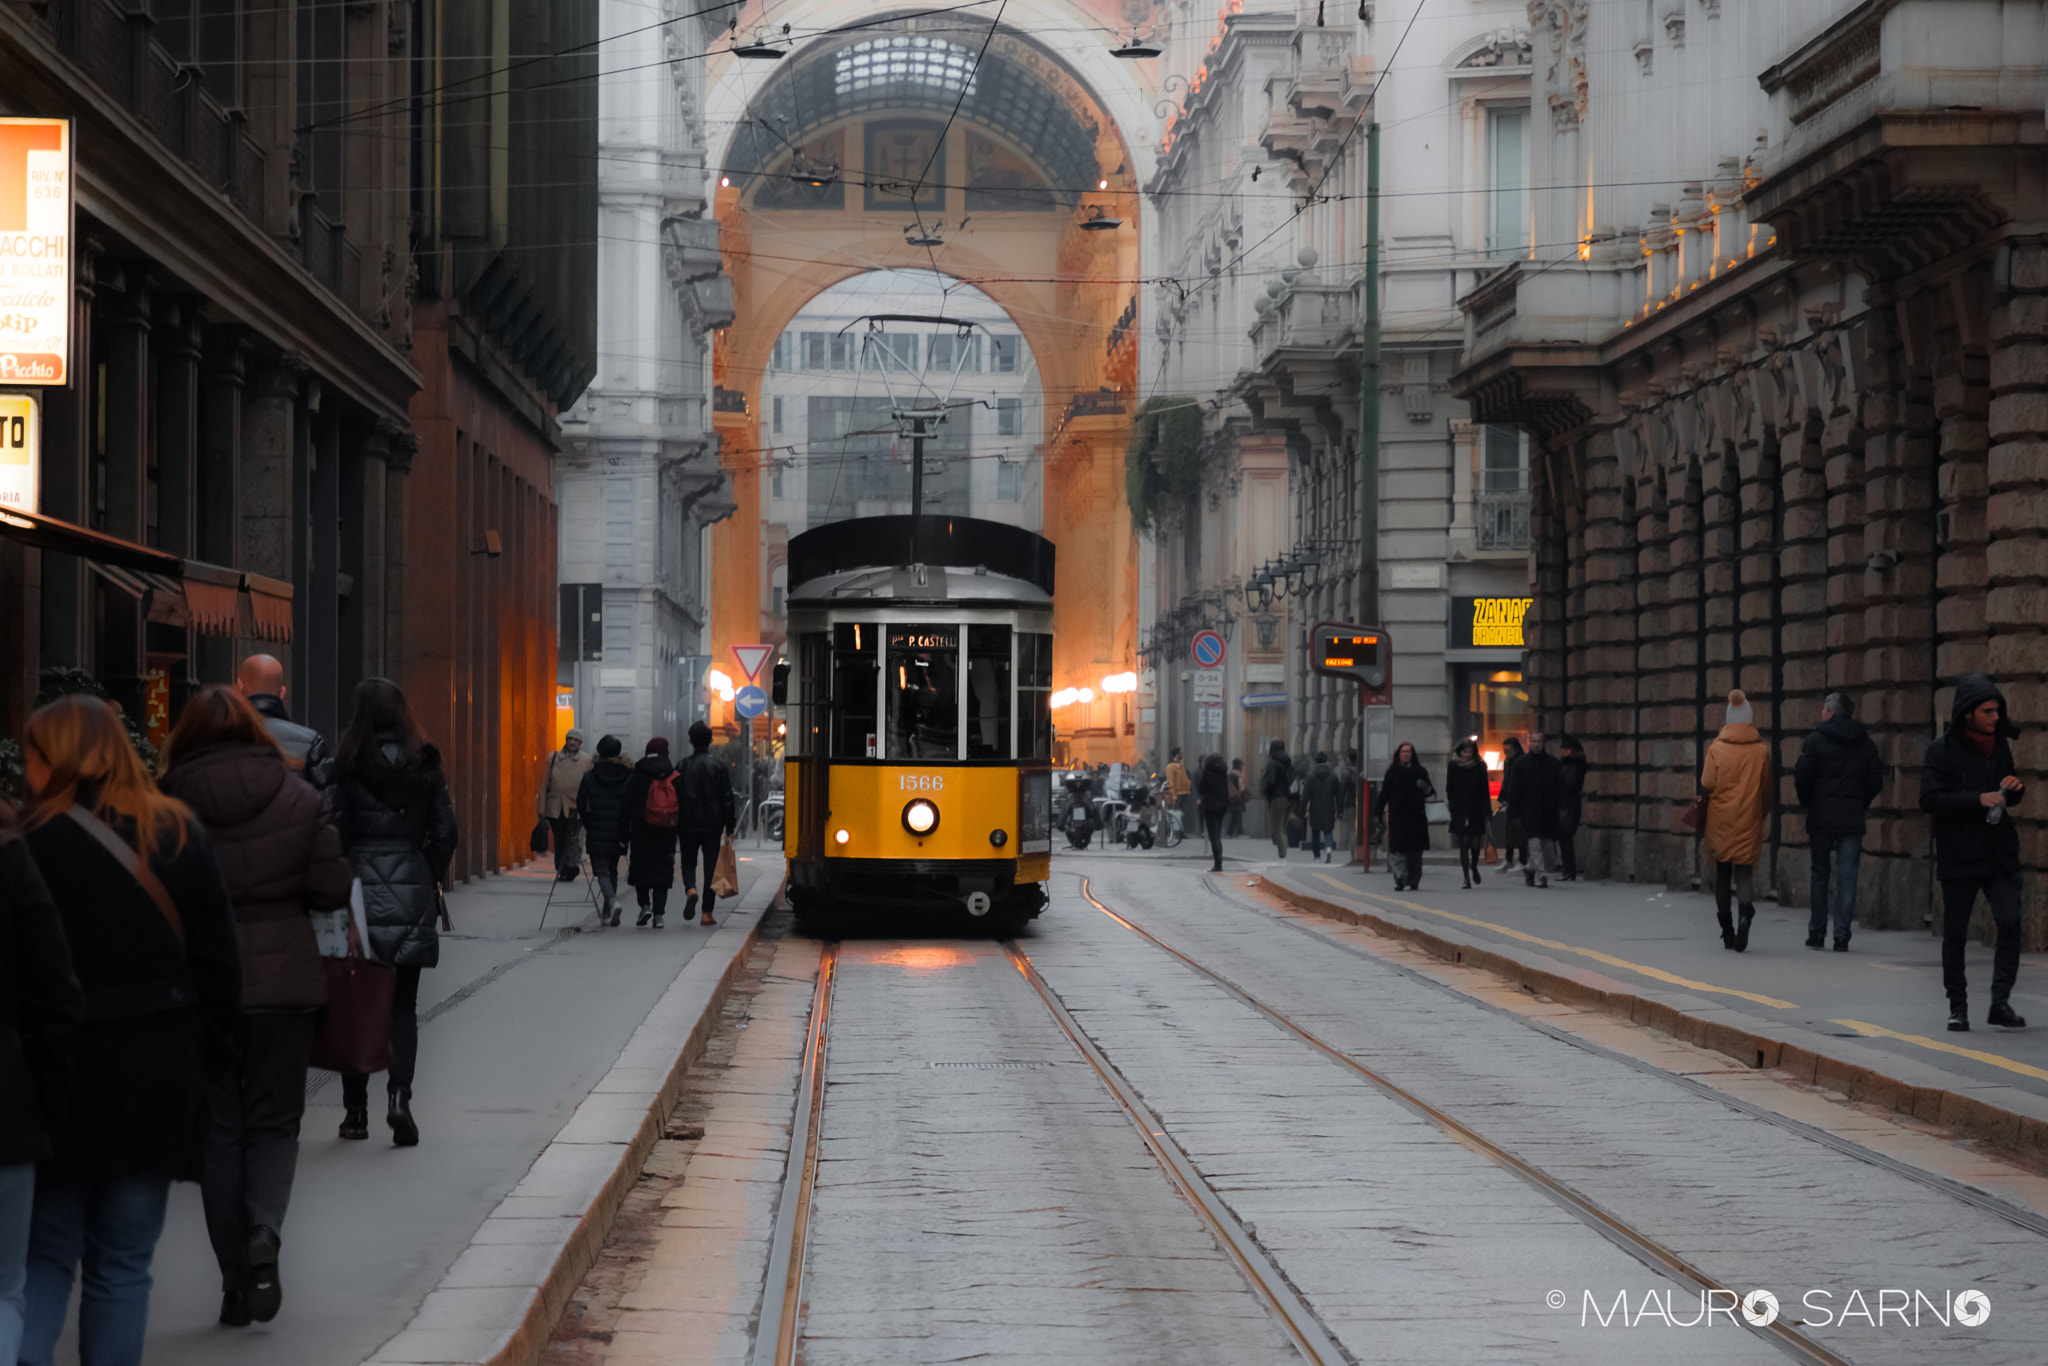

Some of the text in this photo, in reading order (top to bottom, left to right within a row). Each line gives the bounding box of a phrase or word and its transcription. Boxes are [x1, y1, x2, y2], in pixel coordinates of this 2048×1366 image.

[35, 186, 61, 199] 636
[0, 235, 64, 258] ACCHI
[0, 492, 20, 502] RIA
[900, 775, 944, 791] 1566
